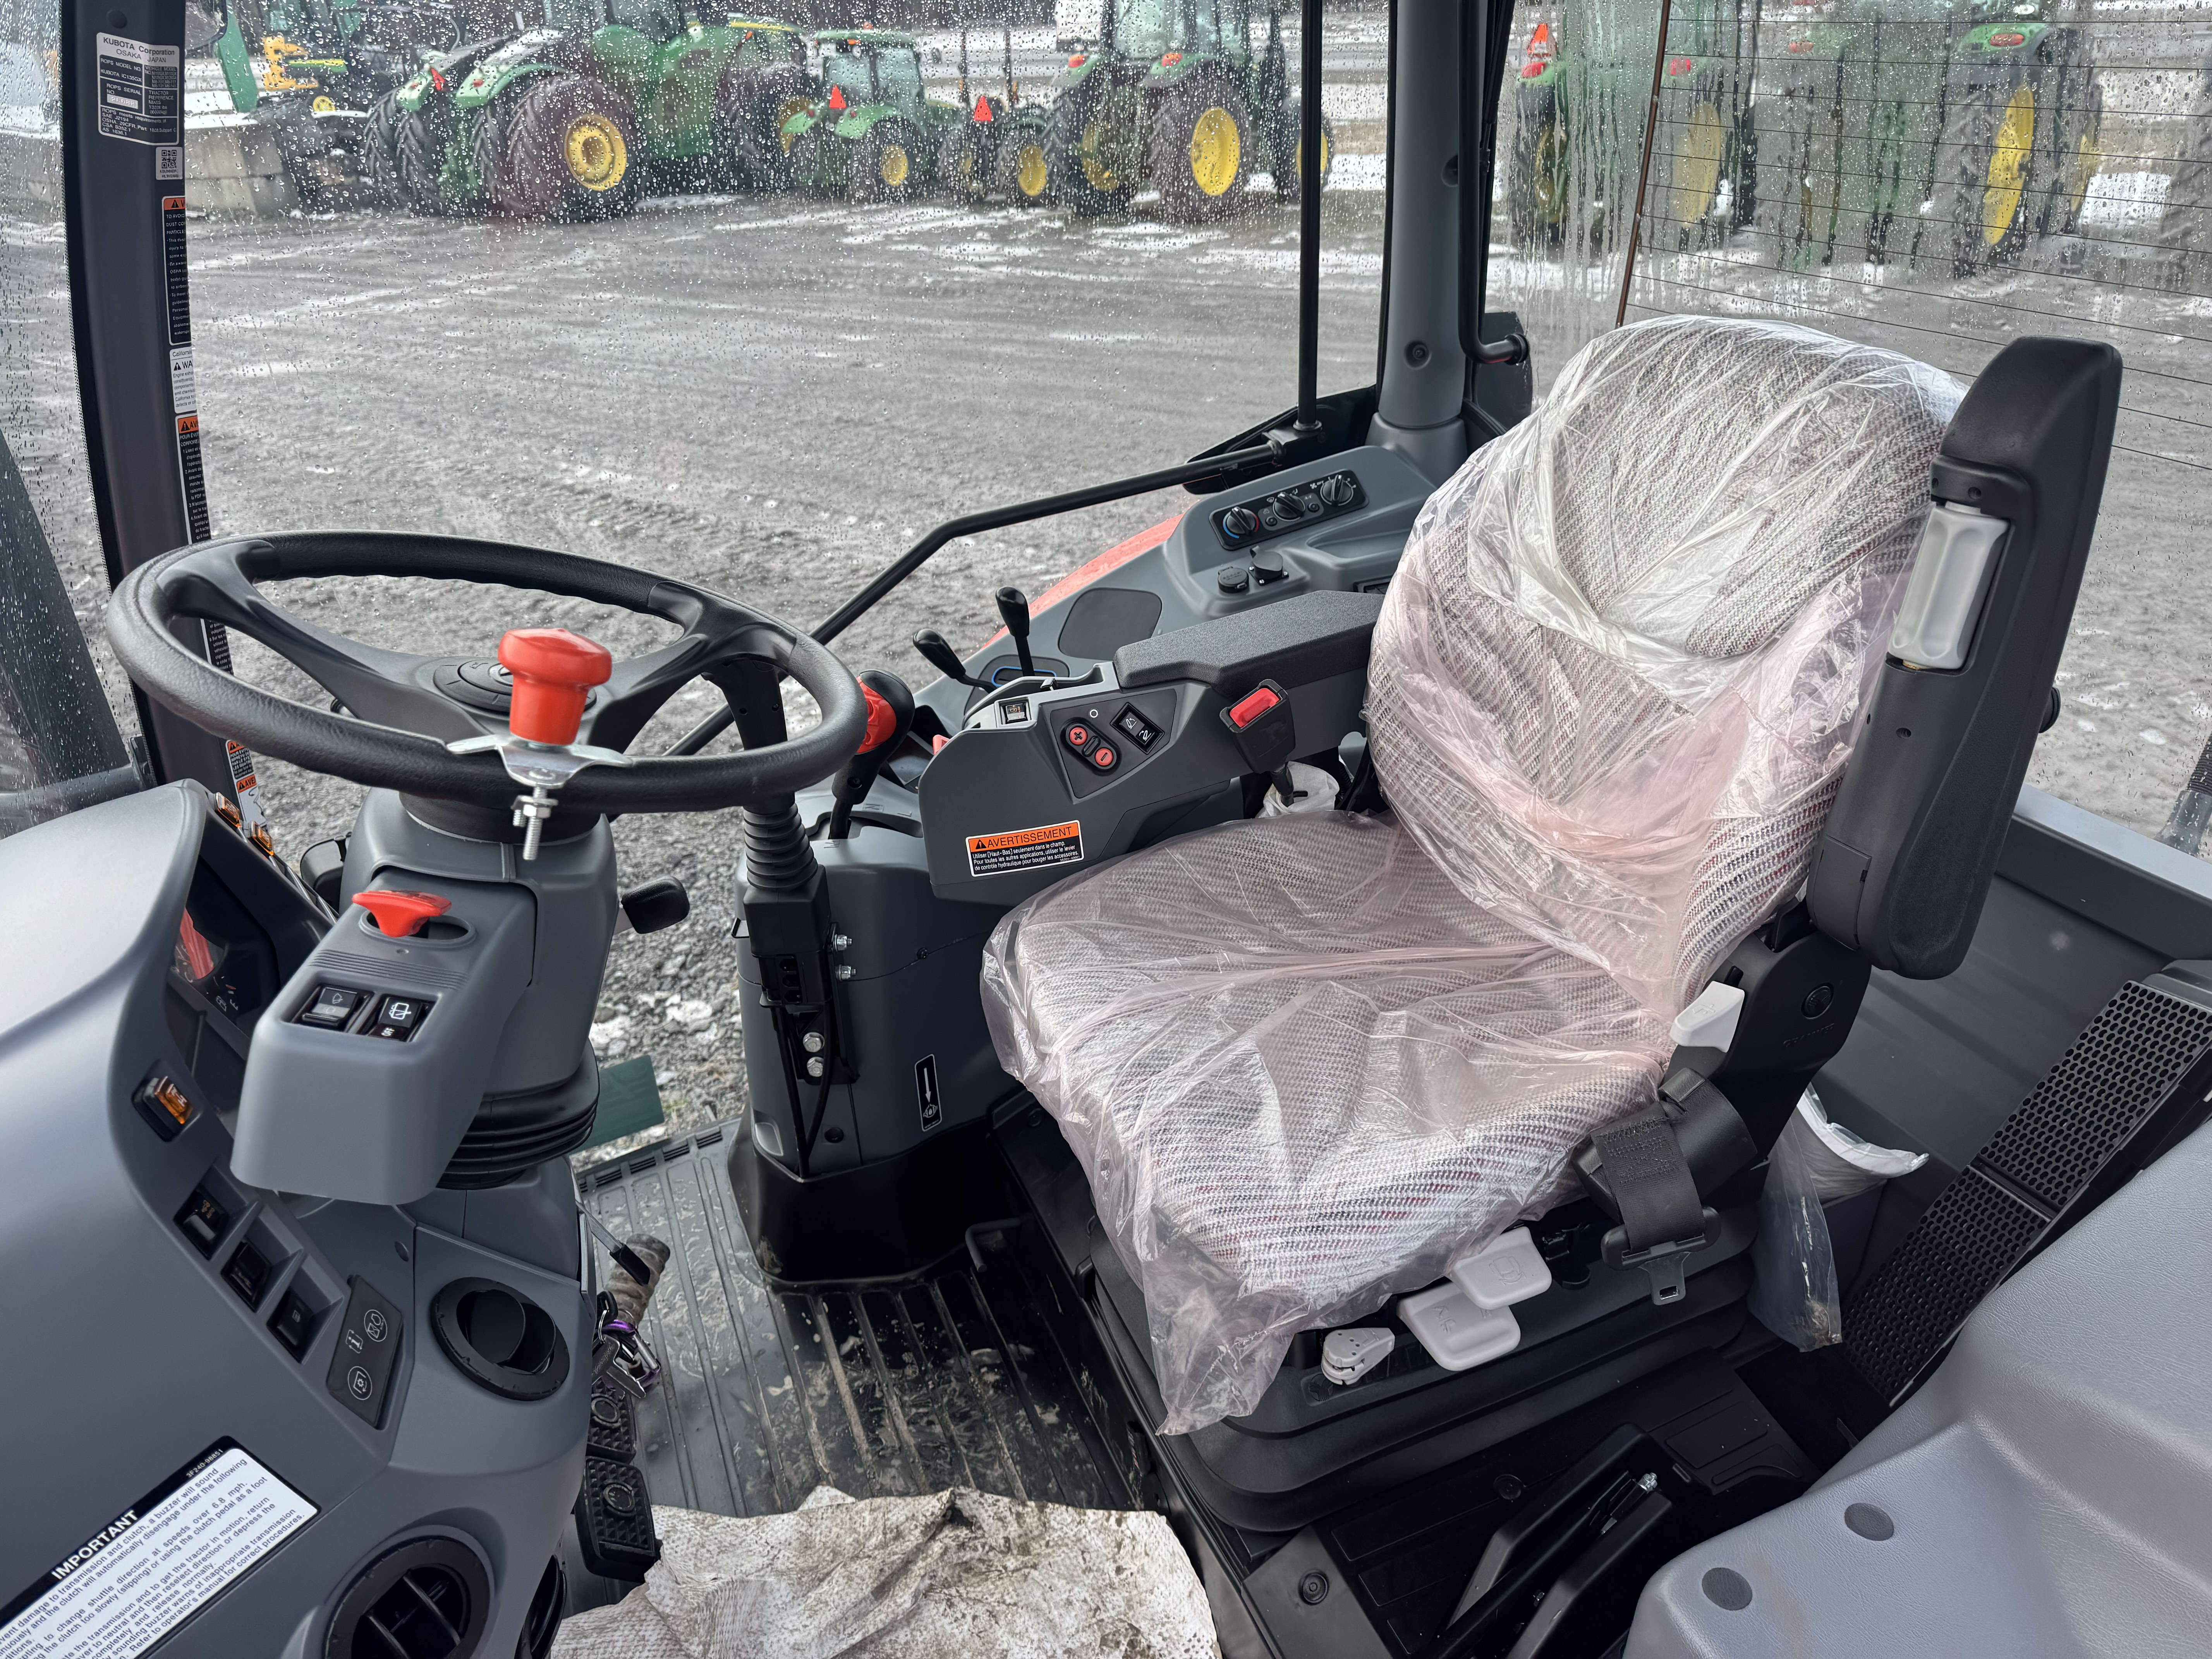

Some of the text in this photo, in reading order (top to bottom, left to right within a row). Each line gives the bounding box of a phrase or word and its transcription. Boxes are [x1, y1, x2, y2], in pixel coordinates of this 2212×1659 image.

[103, 37, 174, 56] KUBOTA Corporation
[117, 49, 141, 60] OSAKA
[987, 826, 1072, 848] AVERTISSEMENT
[997, 860, 1021, 869] hydraulique
[1054, 851, 1079, 859] accessoires.
[1019, 851, 1045, 859] applications,
[381, 1027, 395, 1036] OFF
[17, 1601, 50, 1627] damage
[48, 1594, 59, 1602] to
[57, 1556, 108, 1595] transmission
[106, 1542, 123, 1557] and
[122, 1525, 150, 1544] clutch,
[153, 1497, 181, 1519] buzzer
[180, 1486, 196, 1498] will
[194, 1467, 219, 1488] sound
[30, 1459, 247, 1629] and the clutch will automatically disengage under the following
[41, 1642, 58, 1653] the
[58, 1623, 82, 1642] clutch
[80, 1612, 95, 1624] too
[94, 1593, 119, 1613] slowly
[116, 1567, 151, 1595] (slipping)
[150, 1560, 160, 1568] or
[159, 1544, 182, 1561] using
[179, 1534, 193, 1545] the
[193, 1517, 216, 1535] clutch
[215, 1499, 236, 1519] pedal
[235, 1493, 246, 1502] as
[250, 1476, 268, 1489] foot
[43, 1483, 247, 1642] to change shuttle direction at speeds over 6.8 mph.
[52, 1510, 137, 1579] IMPORTANT
[73, 1640, 88, 1652] the
[87, 1602, 136, 1641] transmission
[135, 1589, 151, 1603] and
[160, 1572, 174, 1584] get
[172, 1562, 186, 1573] the
[185, 1542, 210, 1563] tractor
[219, 1516, 248, 1537] motion,
[246, 1497, 270, 1515] return
[102, 1618, 130, 1641] neutral
[129, 1605, 145, 1620] and
[143, 1592, 163, 1607] then
[161, 1568, 192, 1593] reselect
[192, 1544, 224, 1569] direction
[223, 1536, 233, 1544] or
[233, 1513, 263, 1537] depress
[261, 1503, 275, 1514] the
[112, 1509, 296, 1656] sounding buzzer warns of inappropriate transmission
[129, 1633, 152, 1652] Refer
[160, 1597, 198, 1627] operator's
[197, 1574, 226, 1598] manual
[223, 1566, 237, 1576] for
[236, 1545, 263, 1567] correct
[261, 1515, 305, 1548] procedures.
[134, 1613, 150, 1626] and
[151, 1589, 180, 1613] release
[182, 1563, 216, 1588] normally.
